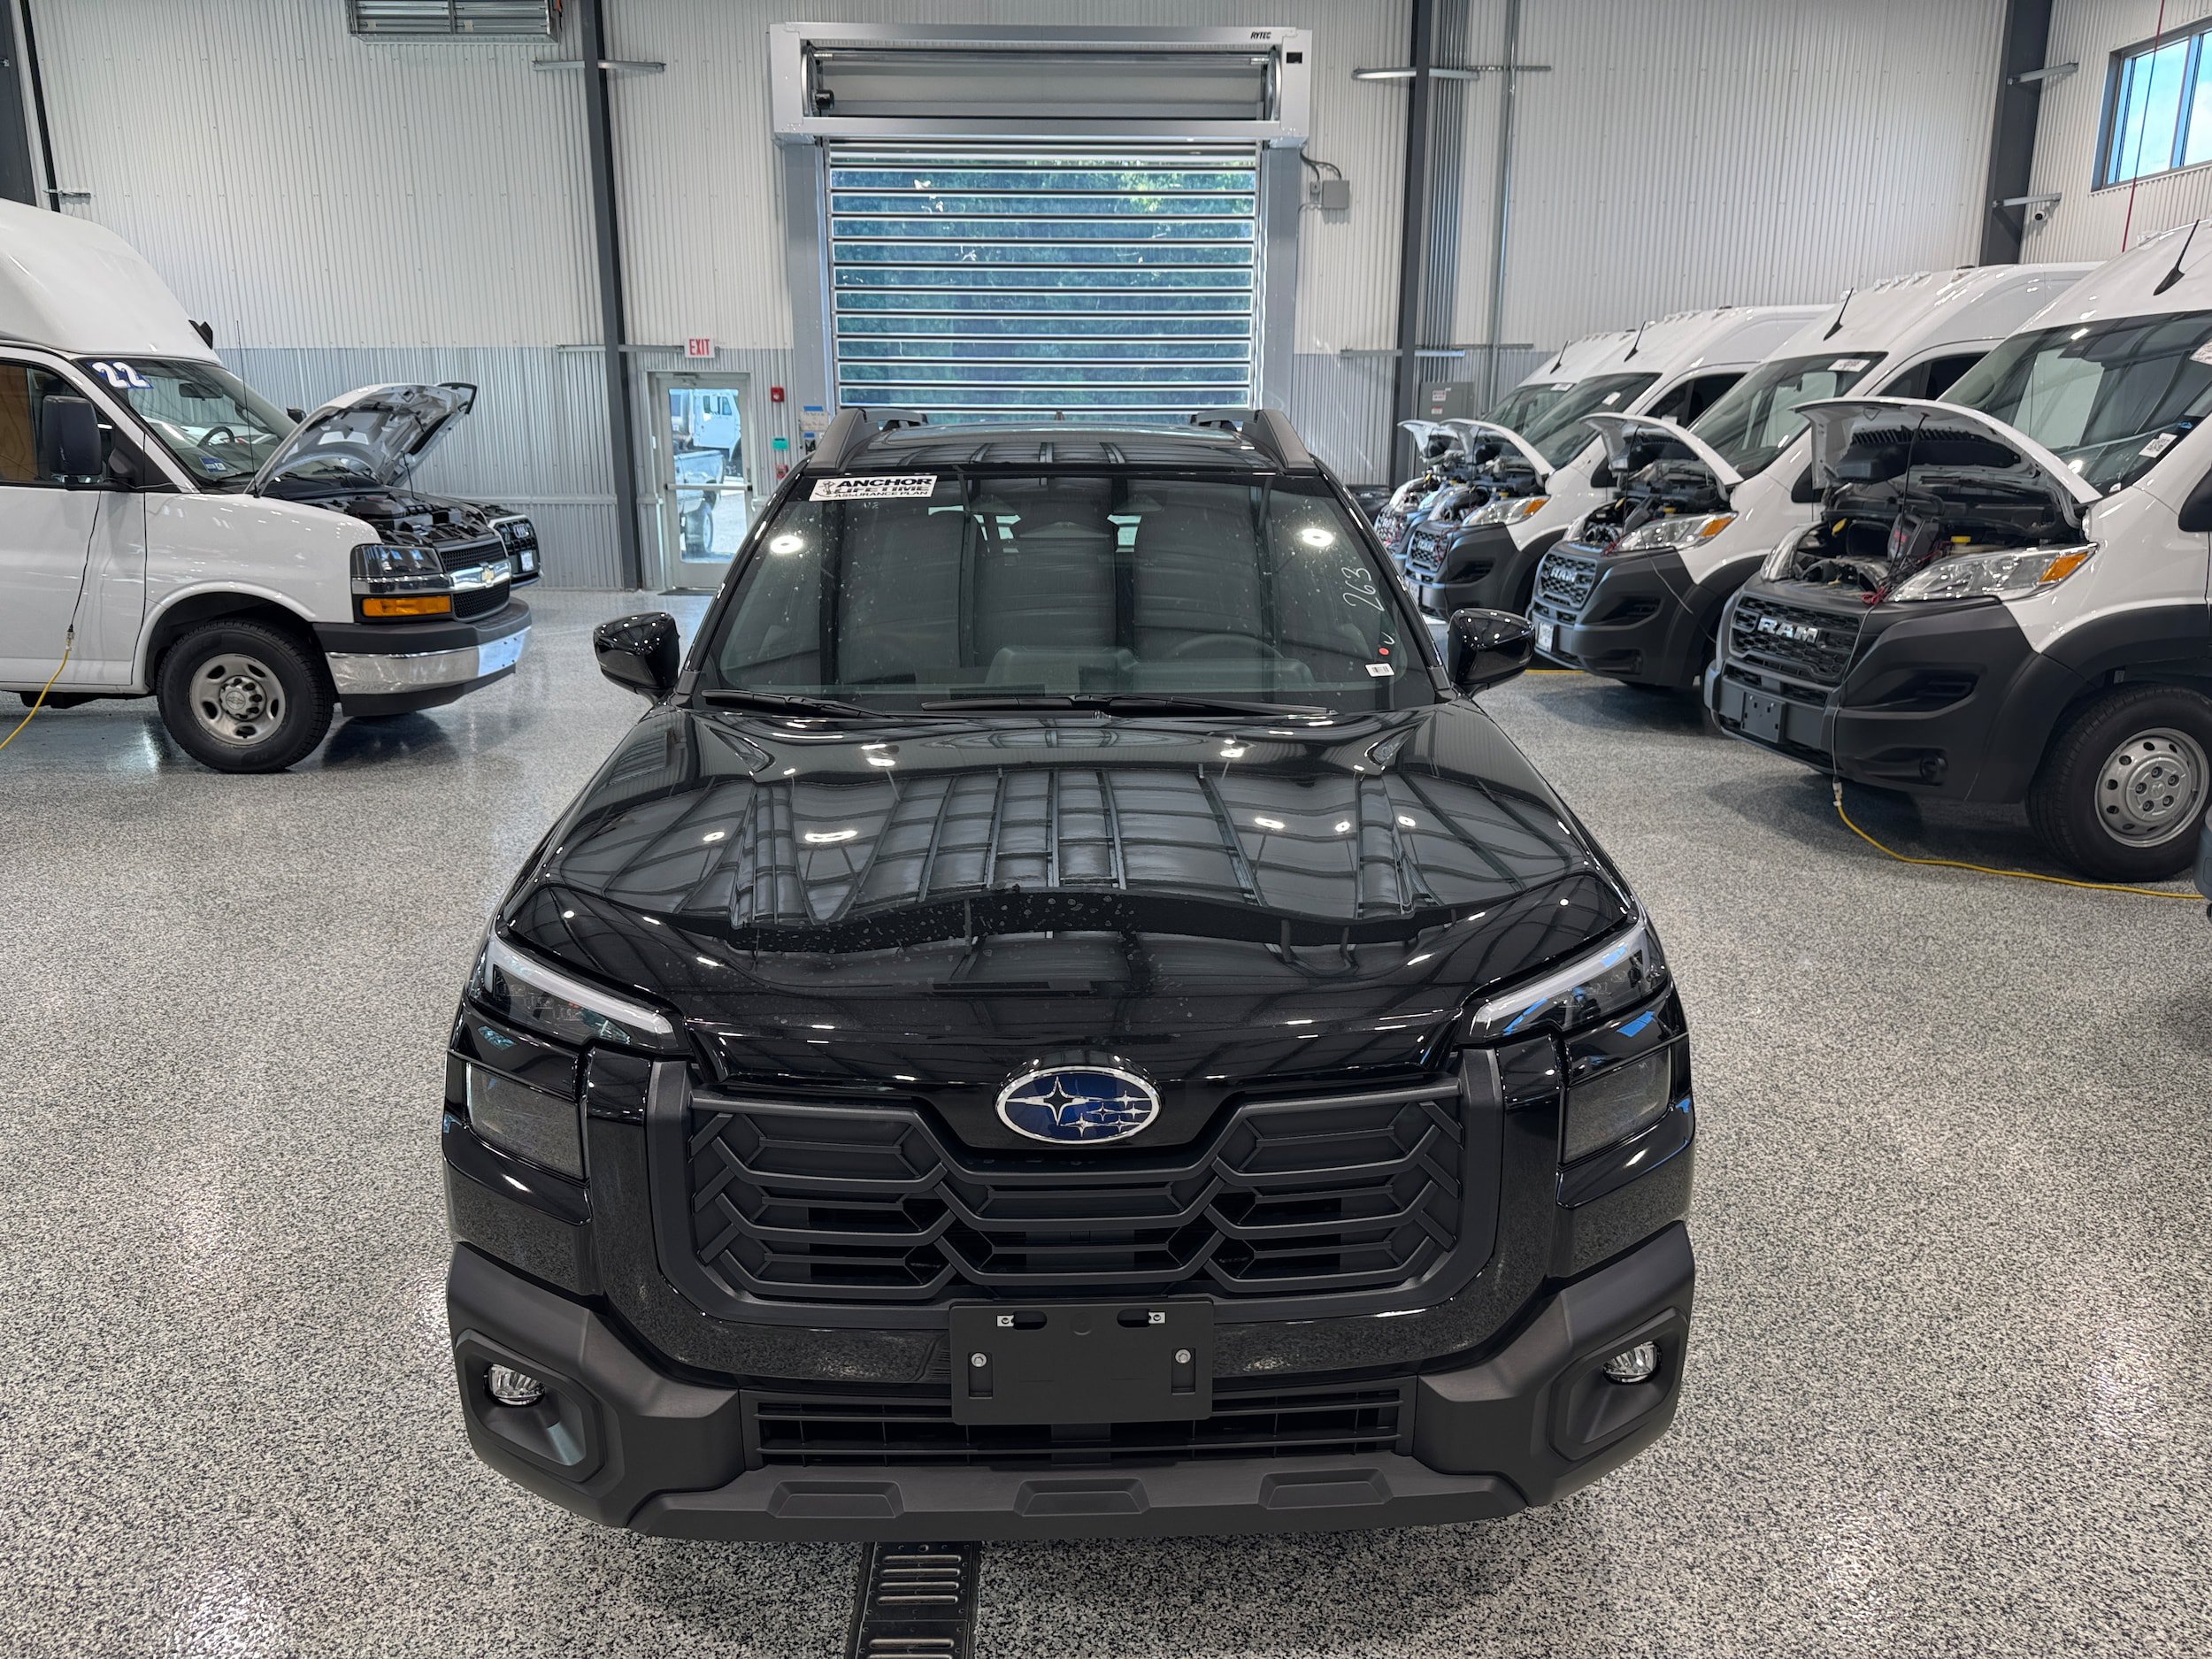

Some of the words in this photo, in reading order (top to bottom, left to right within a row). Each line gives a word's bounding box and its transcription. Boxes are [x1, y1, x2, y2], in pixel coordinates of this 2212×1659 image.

[689, 339, 710, 355] EXIT
[91, 361, 151, 388] 22
[1550, 566, 1578, 582] RAM
[1341, 567, 1385, 611] 263
[1757, 617, 1817, 643] RAM
